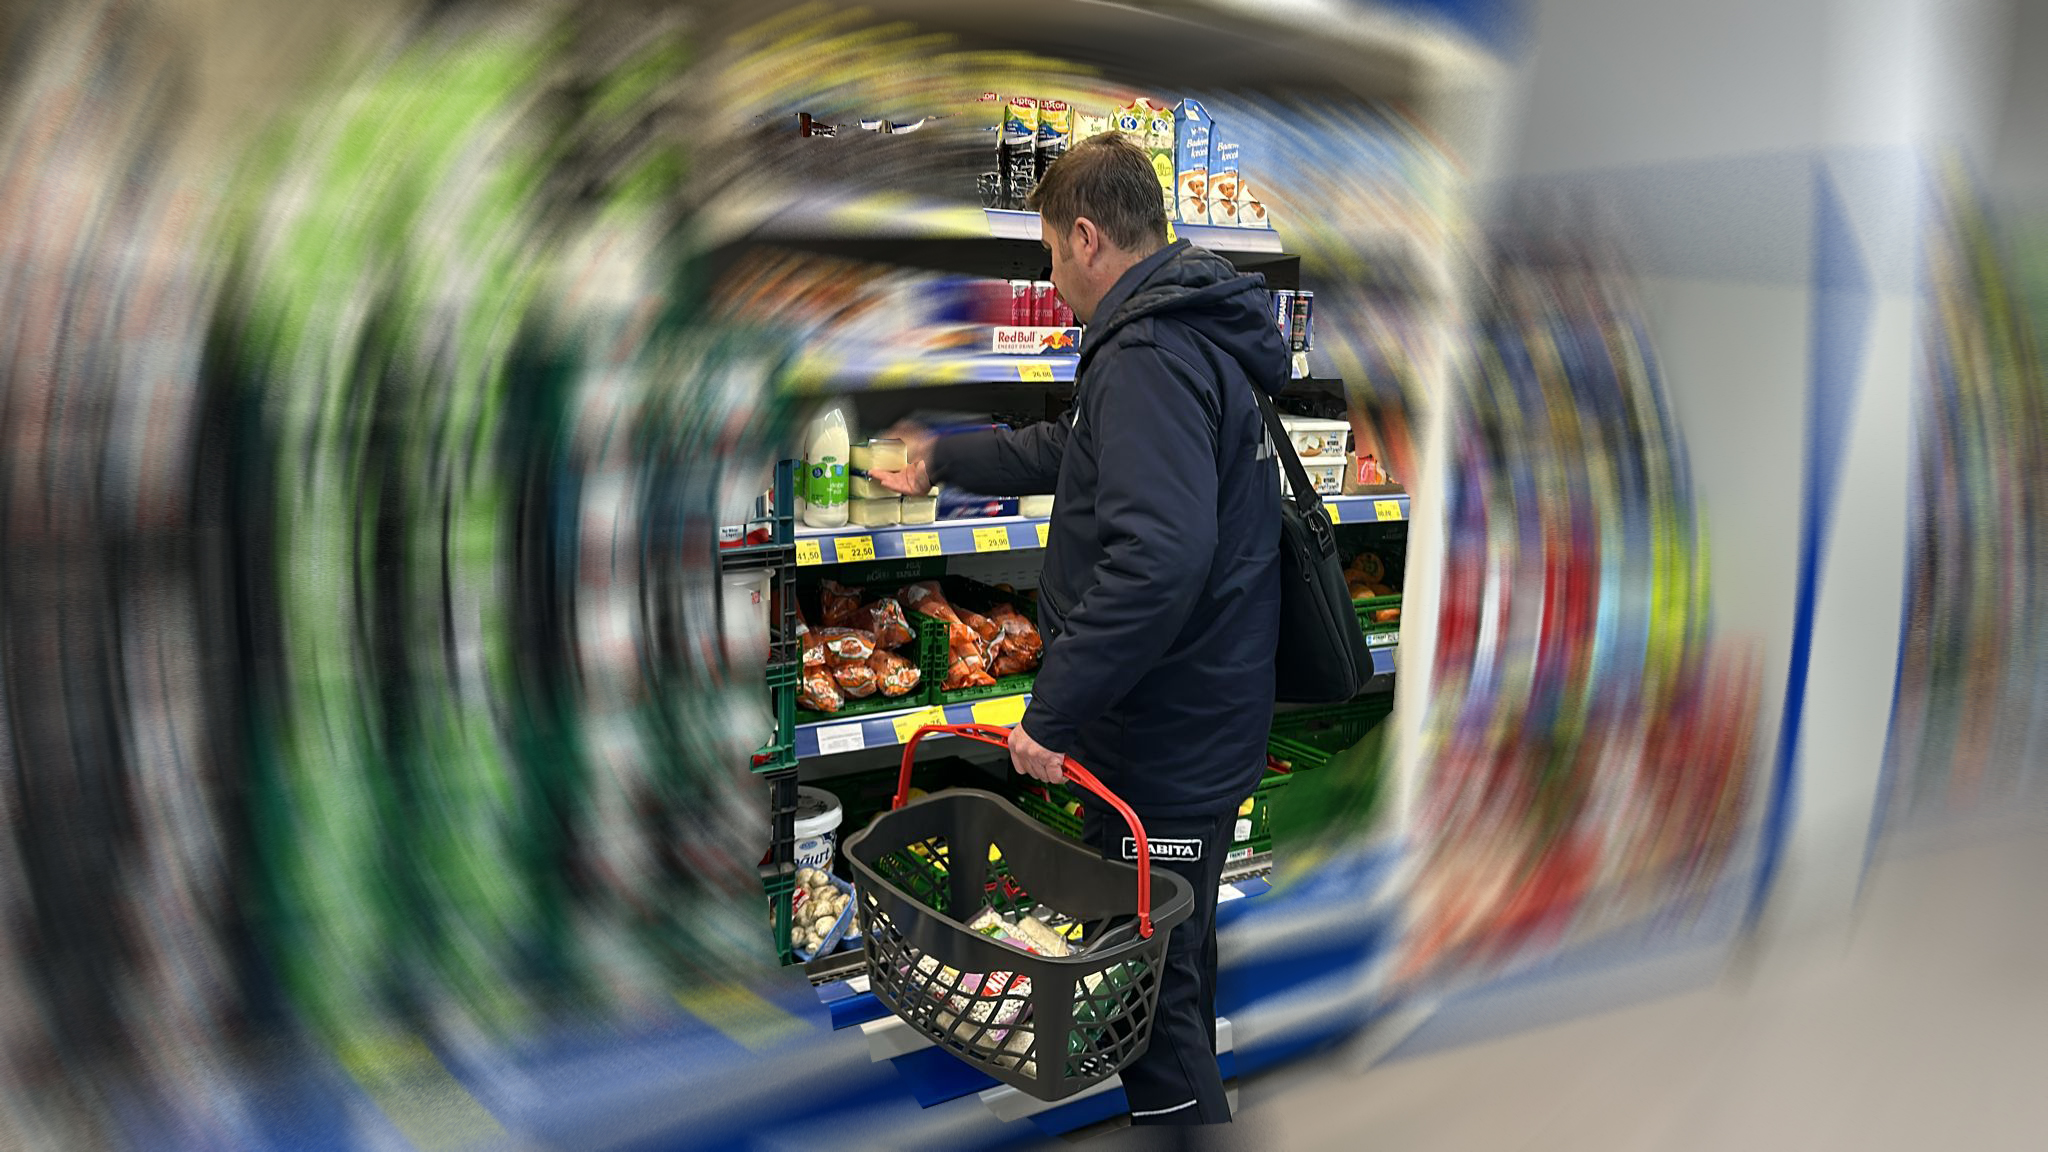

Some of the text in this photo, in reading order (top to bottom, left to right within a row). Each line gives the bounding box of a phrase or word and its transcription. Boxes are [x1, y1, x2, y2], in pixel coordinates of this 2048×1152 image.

[998, 330, 1035, 343] Red Bull
[797, 551, 819, 561] 41,50
[851, 547, 873, 557] 22,50
